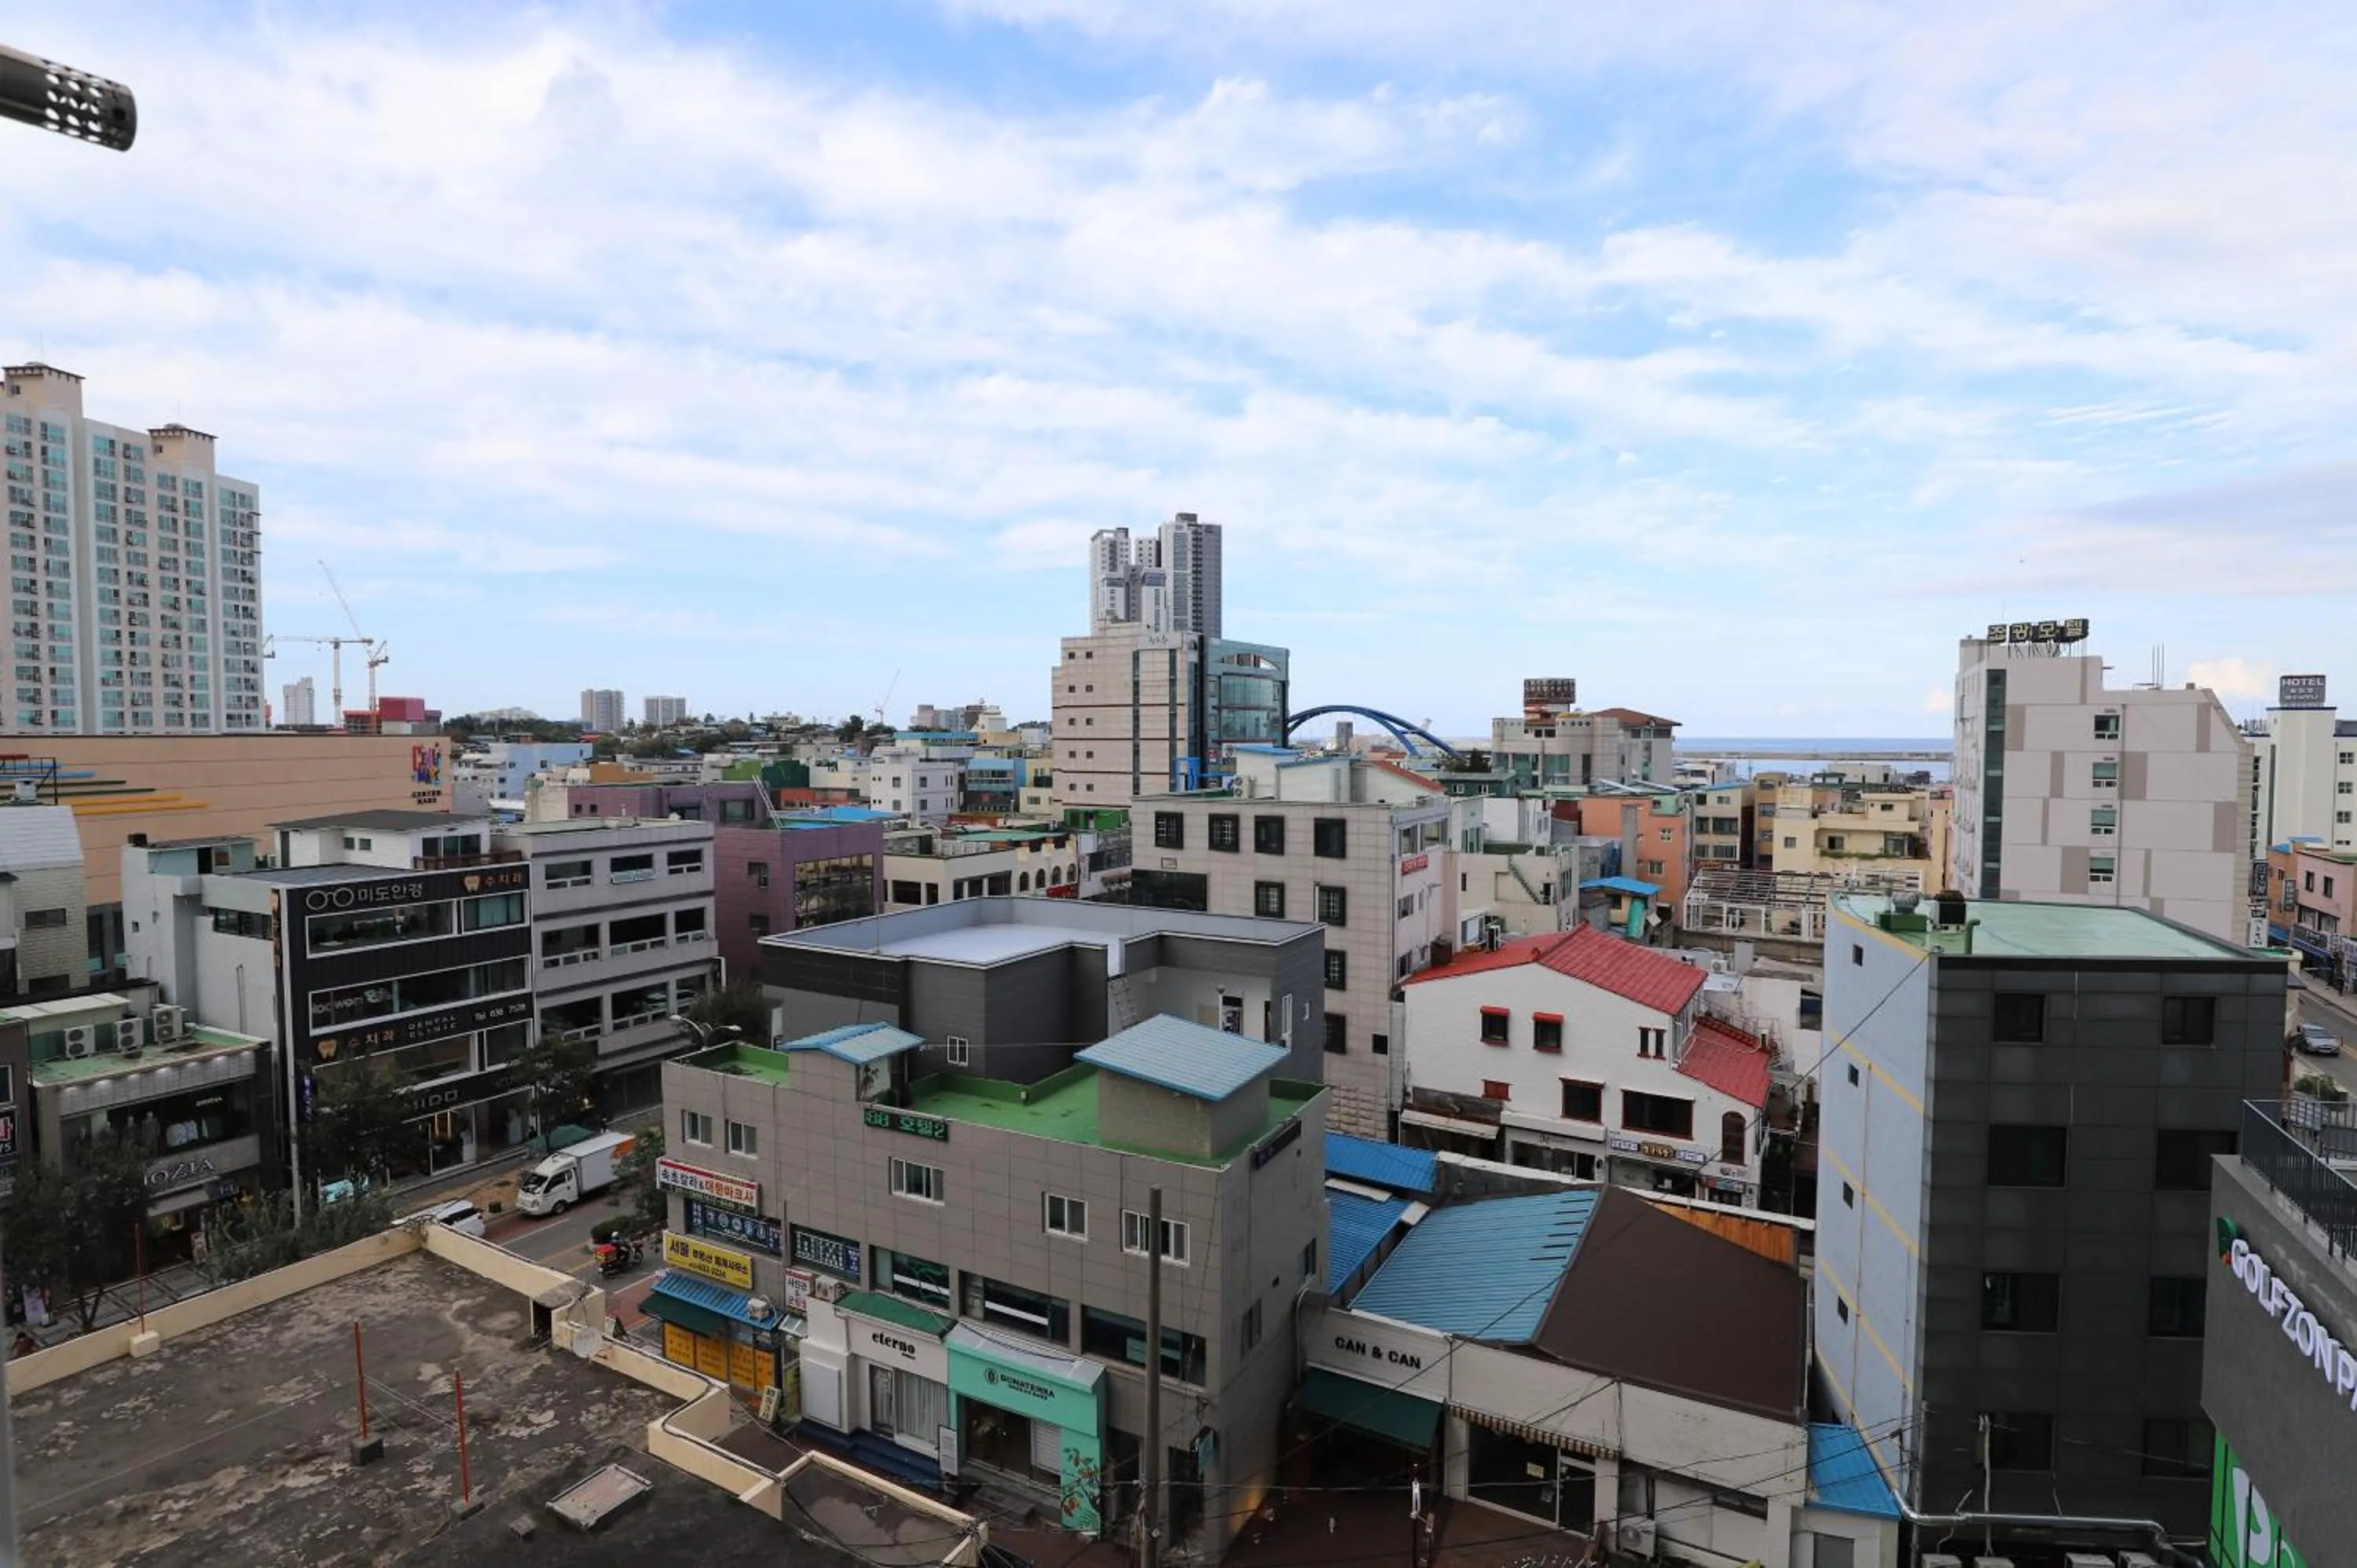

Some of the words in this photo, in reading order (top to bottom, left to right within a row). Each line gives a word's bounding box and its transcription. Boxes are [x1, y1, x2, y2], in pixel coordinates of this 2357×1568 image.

[1989, 619, 2084, 641] 조광모텔
[357, 882, 423, 903] 미도안경
[871, 1332, 915, 1354] eterno
[1335, 1336, 1366, 1357] CAN
[1372, 1346, 1383, 1360] &
[1388, 1350, 1421, 1369] CAN
